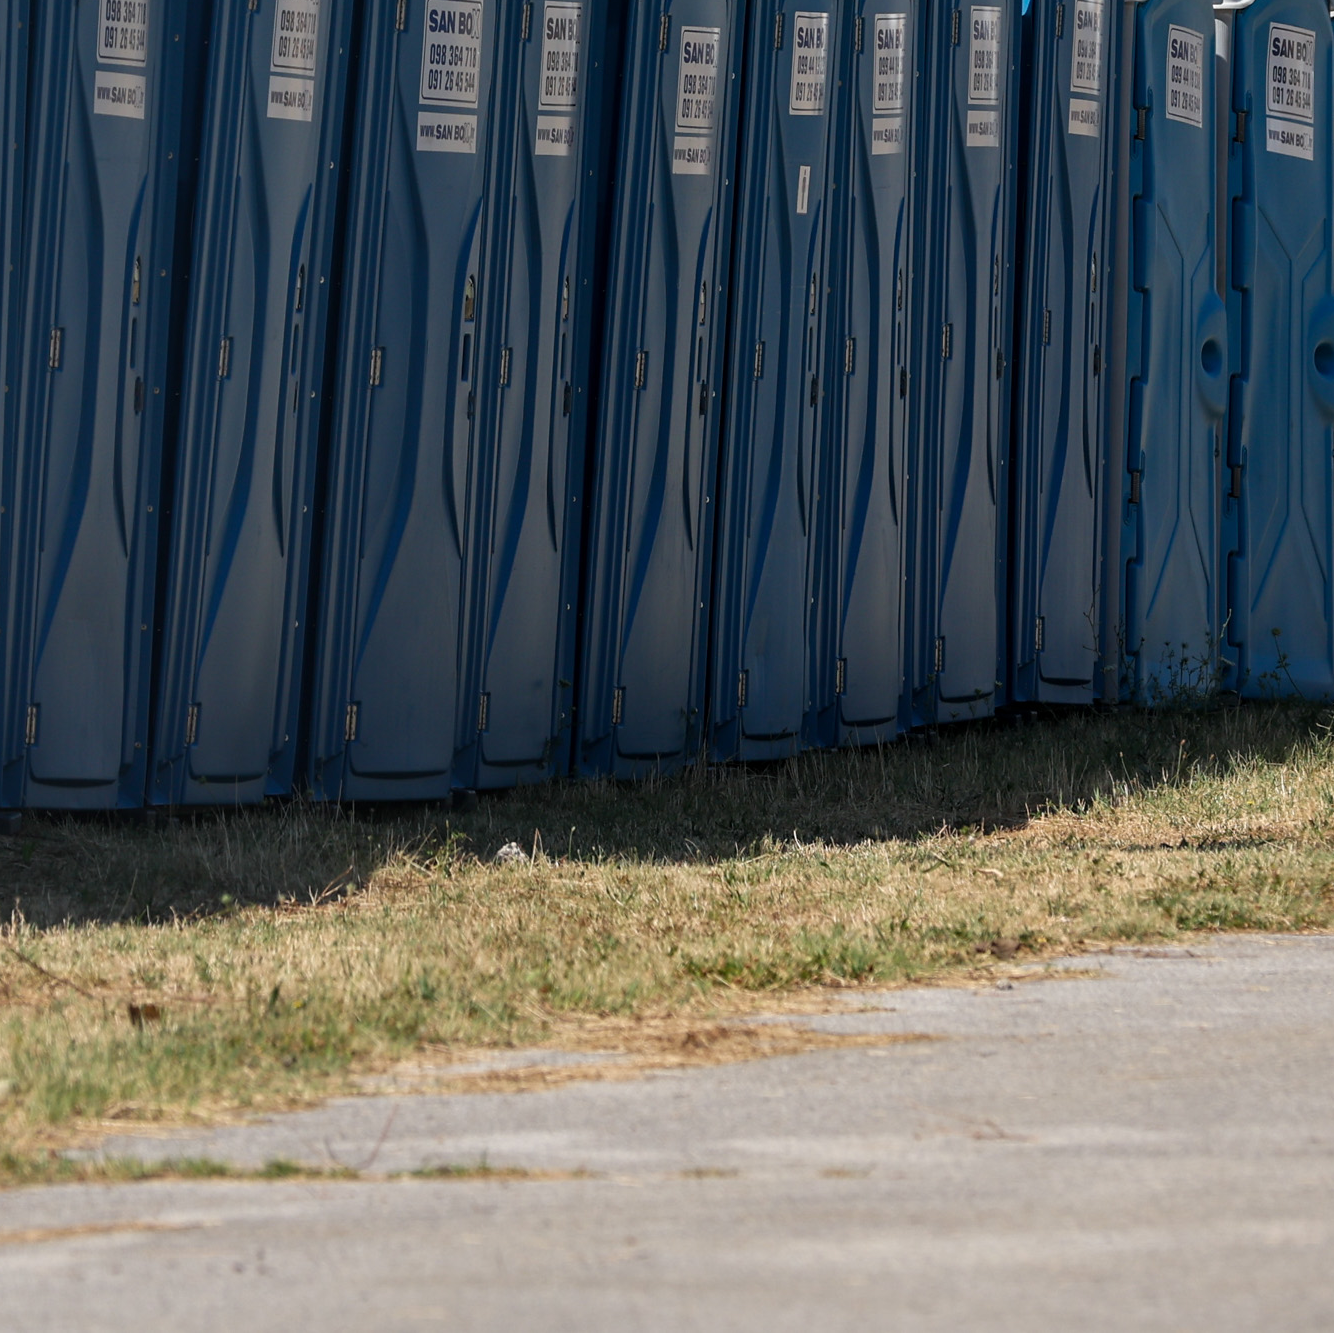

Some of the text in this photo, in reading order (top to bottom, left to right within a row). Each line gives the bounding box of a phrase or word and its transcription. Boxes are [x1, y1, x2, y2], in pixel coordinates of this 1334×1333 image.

[106, 0, 121, 22] 098
[123, 1, 135, 23] 364
[281, 10, 294, 32] 098
[429, 9, 455, 33] SAN
[1077, 10, 1092, 29] SAN
[105, 26, 117, 48] 091
[547, 18, 566, 40] SAN
[797, 27, 814, 48] SAN
[878, 29, 893, 50] SAN
[974, 20, 989, 40] SAN
[279, 36, 290, 57] 091
[430, 43, 446, 65] 098
[449, 45, 463, 66] 364
[684, 42, 704, 64] SAN
[1171, 39, 1188, 61] SAN
[1272, 37, 1294, 58] SAN
[547, 51, 559, 71] 098
[428, 69, 442, 90] 091
[545, 76, 556, 96] 091
[684, 74, 696, 94] 098
[1273, 66, 1287, 84] 098
[1289, 68, 1300, 86] 364
[1273, 86, 1284, 104] 091
